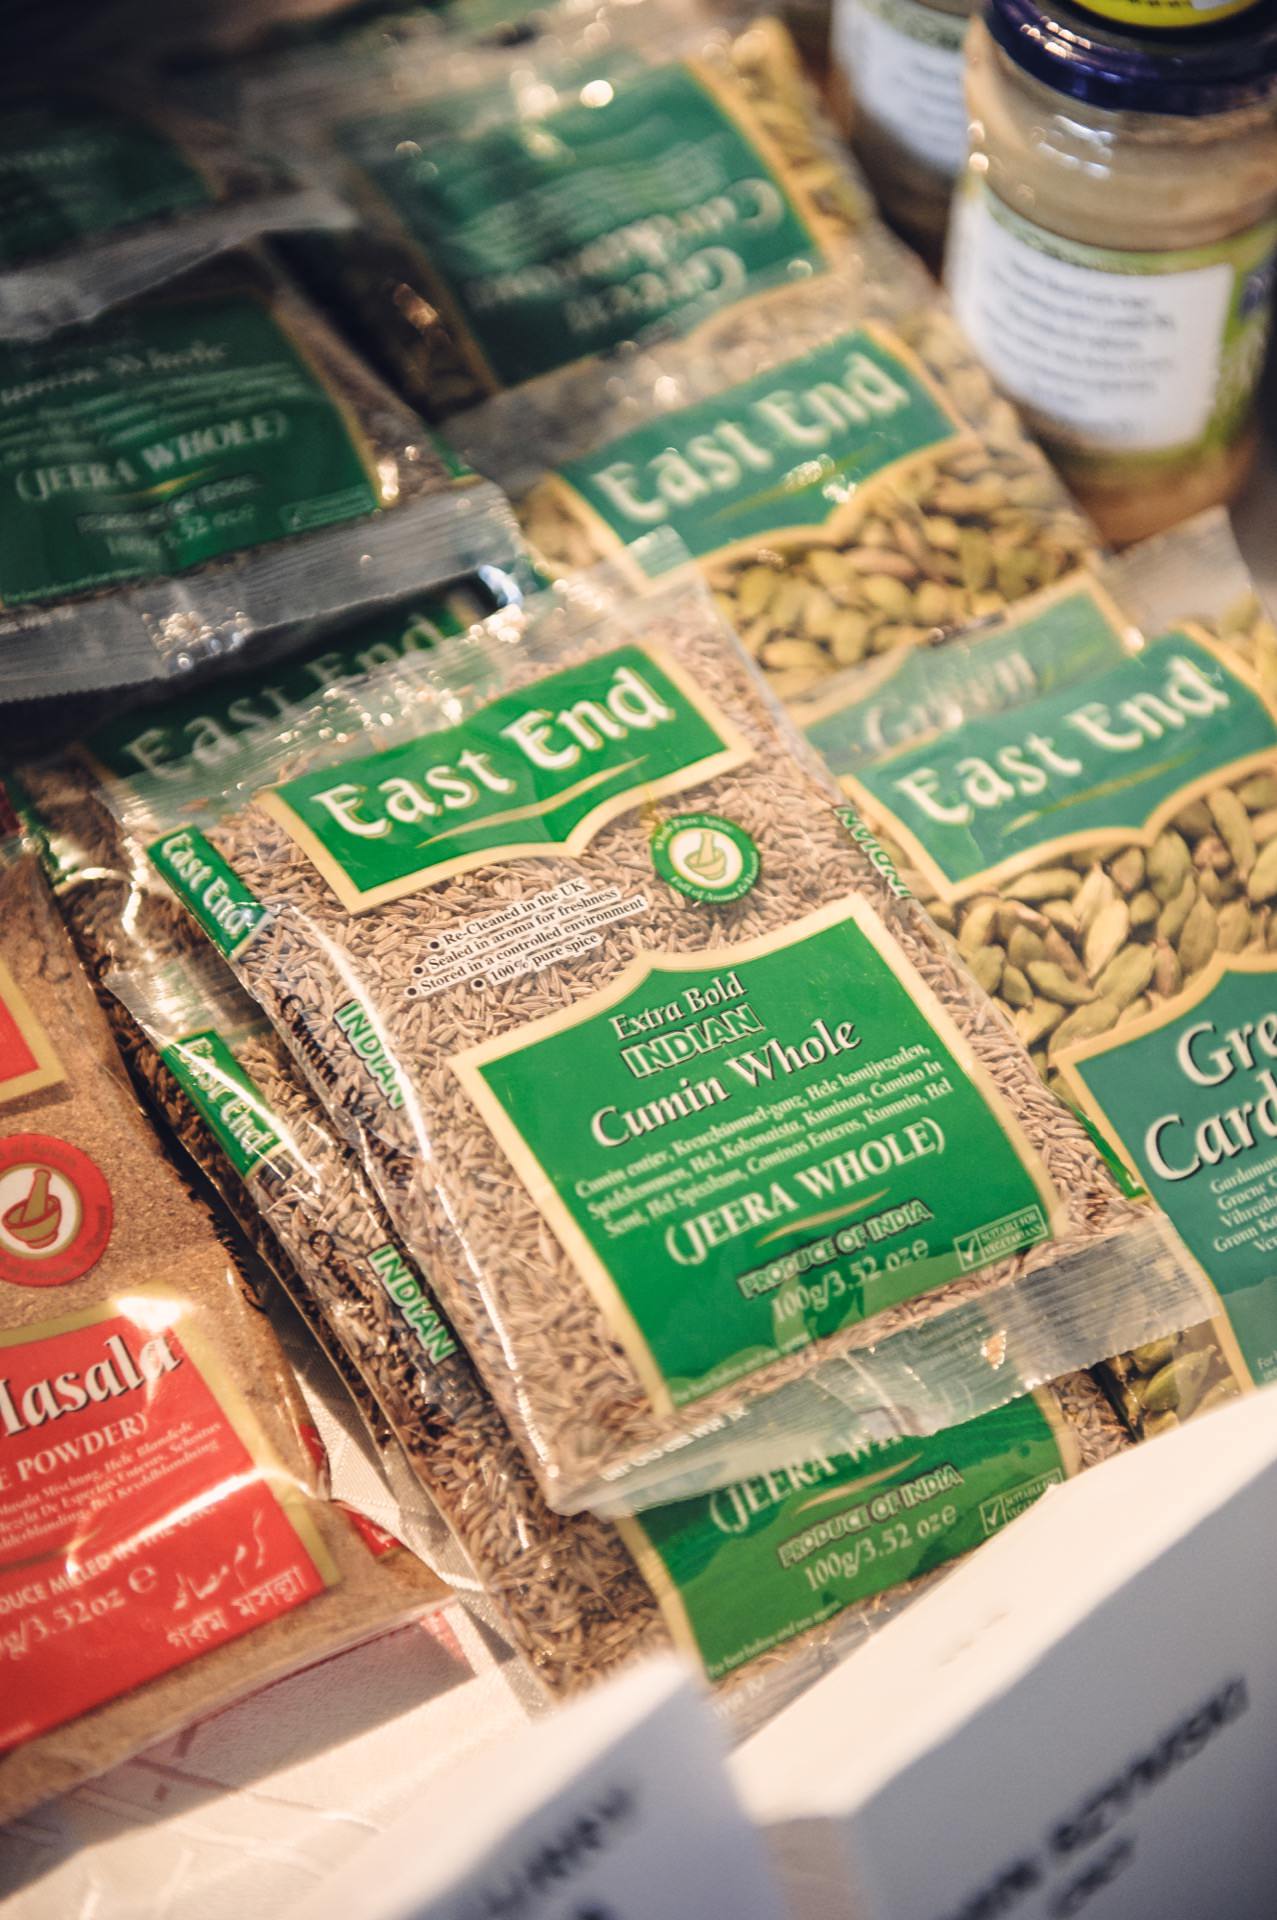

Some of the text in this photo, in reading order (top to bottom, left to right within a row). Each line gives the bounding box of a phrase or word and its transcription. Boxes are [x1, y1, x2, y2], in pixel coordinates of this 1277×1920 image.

[590, 351, 910, 522] East End
[126, 613, 447, 781] East End
[893, 733, 1082, 824] East
[1065, 655, 1230, 751] End
[309, 665, 675, 838] East End
[162, 832, 250, 938] East End
[427, 883, 617, 971] Sealed in aroma for freshness
[442, 878, 585, 946] Re-Cleaned in the UK
[419, 892, 644, 993] Stored in a controlled environment
[489, 931, 599, 982] 100% pure spice
[334, 1001, 405, 1110] INDIAN
[608, 971, 748, 1040] Extra Bold
[621, 1002, 766, 1079] INDIAN
[218, 1101, 275, 1154] End
[589, 1018, 862, 1148] Cumin Whole
[744, 1136, 809, 1175] Cominos
[922, 1074, 953, 1100] Hel
[867, 1063, 925, 1098] Cumino
[573, 1164, 627, 1198] Cumin
[803, 1074, 840, 1101] Hele
[665, 1118, 946, 1265] (JEERA WHOLE)
[737, 1198, 935, 1300] PRODUCE OF INDIA
[772, 1256, 883, 1323] 100g/3.52
[367, 1244, 459, 1365] INDIAN
[16, 1410, 152, 1483] POWDER)
[777, 1509, 871, 1570] PRODUCE
[869, 1494, 902, 1523] OF
[897, 1463, 965, 1509] INDIA
[803, 1524, 913, 1593] 100g/3.52
